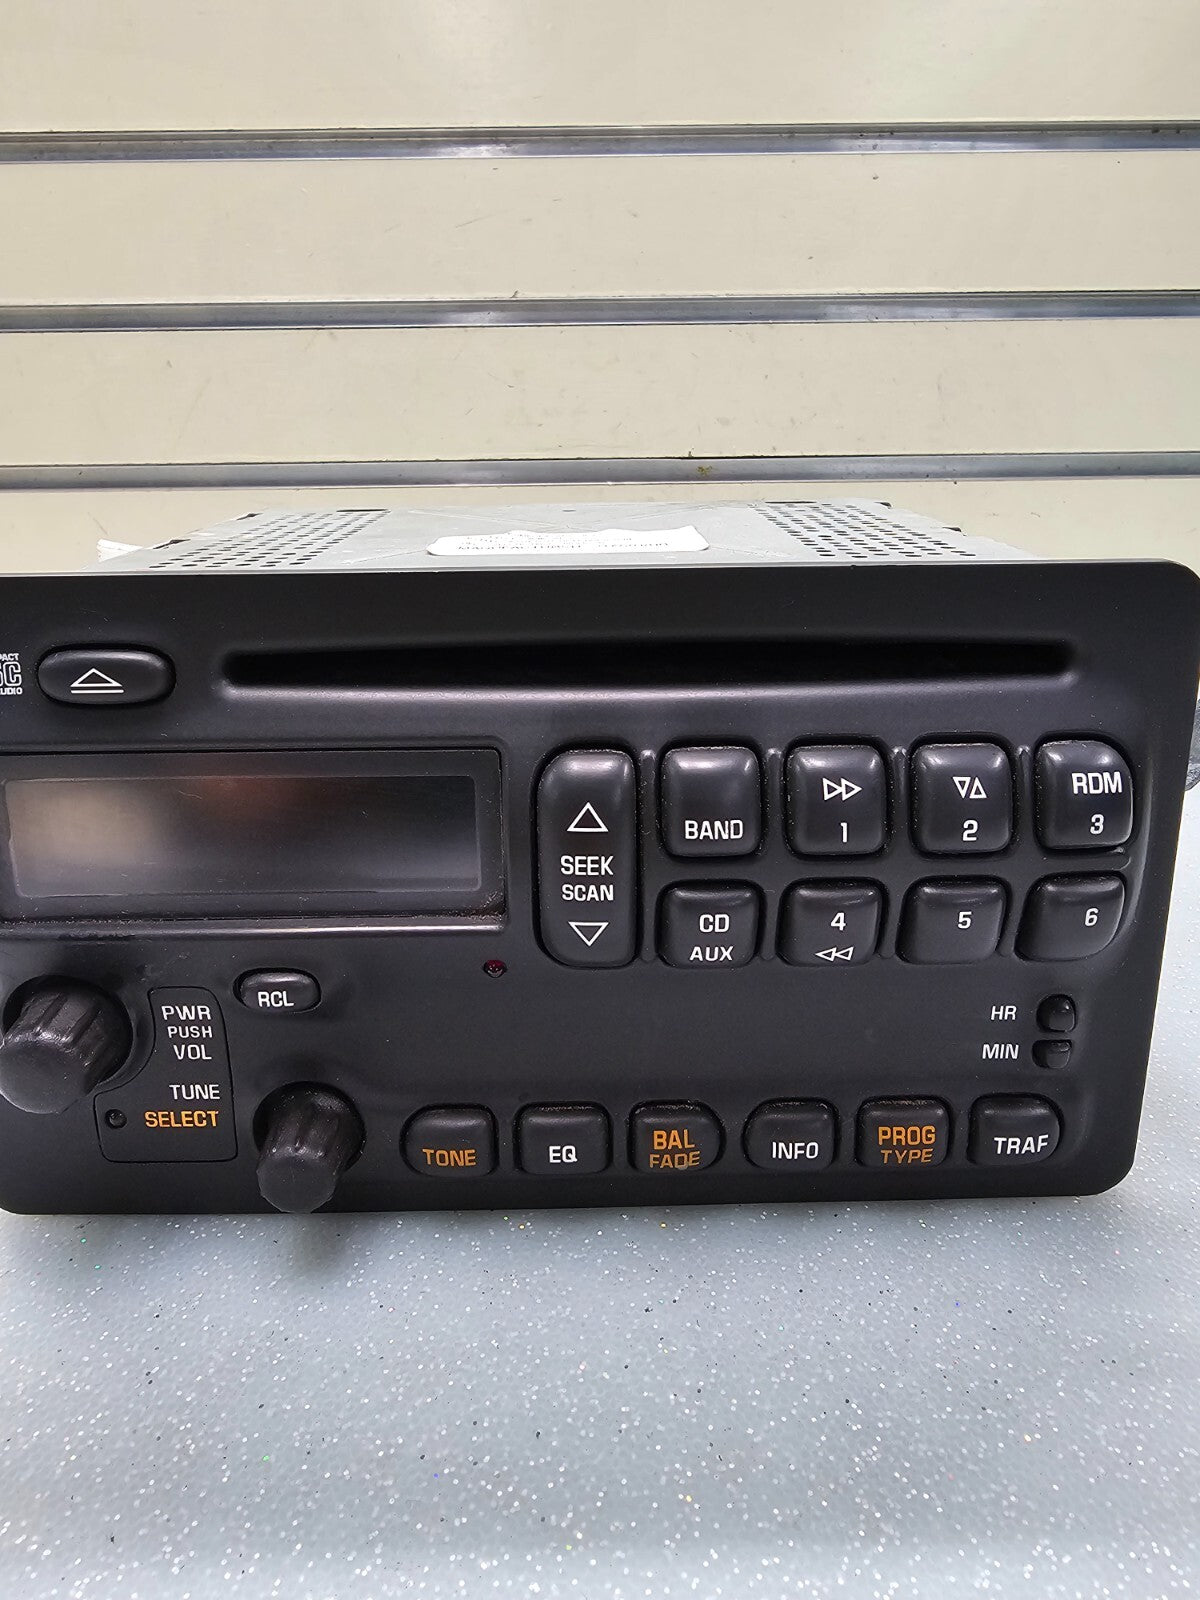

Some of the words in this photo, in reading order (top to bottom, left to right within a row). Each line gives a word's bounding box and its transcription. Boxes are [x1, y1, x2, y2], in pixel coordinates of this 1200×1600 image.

[1071, 771, 1123, 795] RDM
[684, 819, 744, 840] BAND
[839, 822, 848, 843] 1
[962, 819, 978, 842] 2
[1089, 813, 1105, 835] 3
[560, 855, 614, 876] SEEK
[561, 883, 614, 903] SCAN
[699, 913, 730, 933] CD
[830, 912, 847, 931] 4
[957, 911, 972, 930] 5
[1084, 907, 1099, 927] 6
[689, 945, 734, 962] AUX
[257, 990, 295, 1008] RCL
[161, 1005, 212, 1021] PWR
[990, 1005, 1017, 1021] HR
[167, 1025, 213, 1039] PUSH
[173, 1044, 212, 1061] VOL
[982, 1043, 1019, 1060] MIN
[168, 1084, 221, 1101] TUNE
[144, 1110, 219, 1128] SELECT
[653, 1129, 695, 1150] BAL
[878, 1125, 936, 1146] PROG
[993, 1134, 1049, 1155] TRAF
[422, 1148, 477, 1168] TONE
[548, 1145, 578, 1164] EQ
[649, 1151, 701, 1169] FADE
[772, 1141, 819, 1160] INFO
[880, 1148, 934, 1165] TYPE
